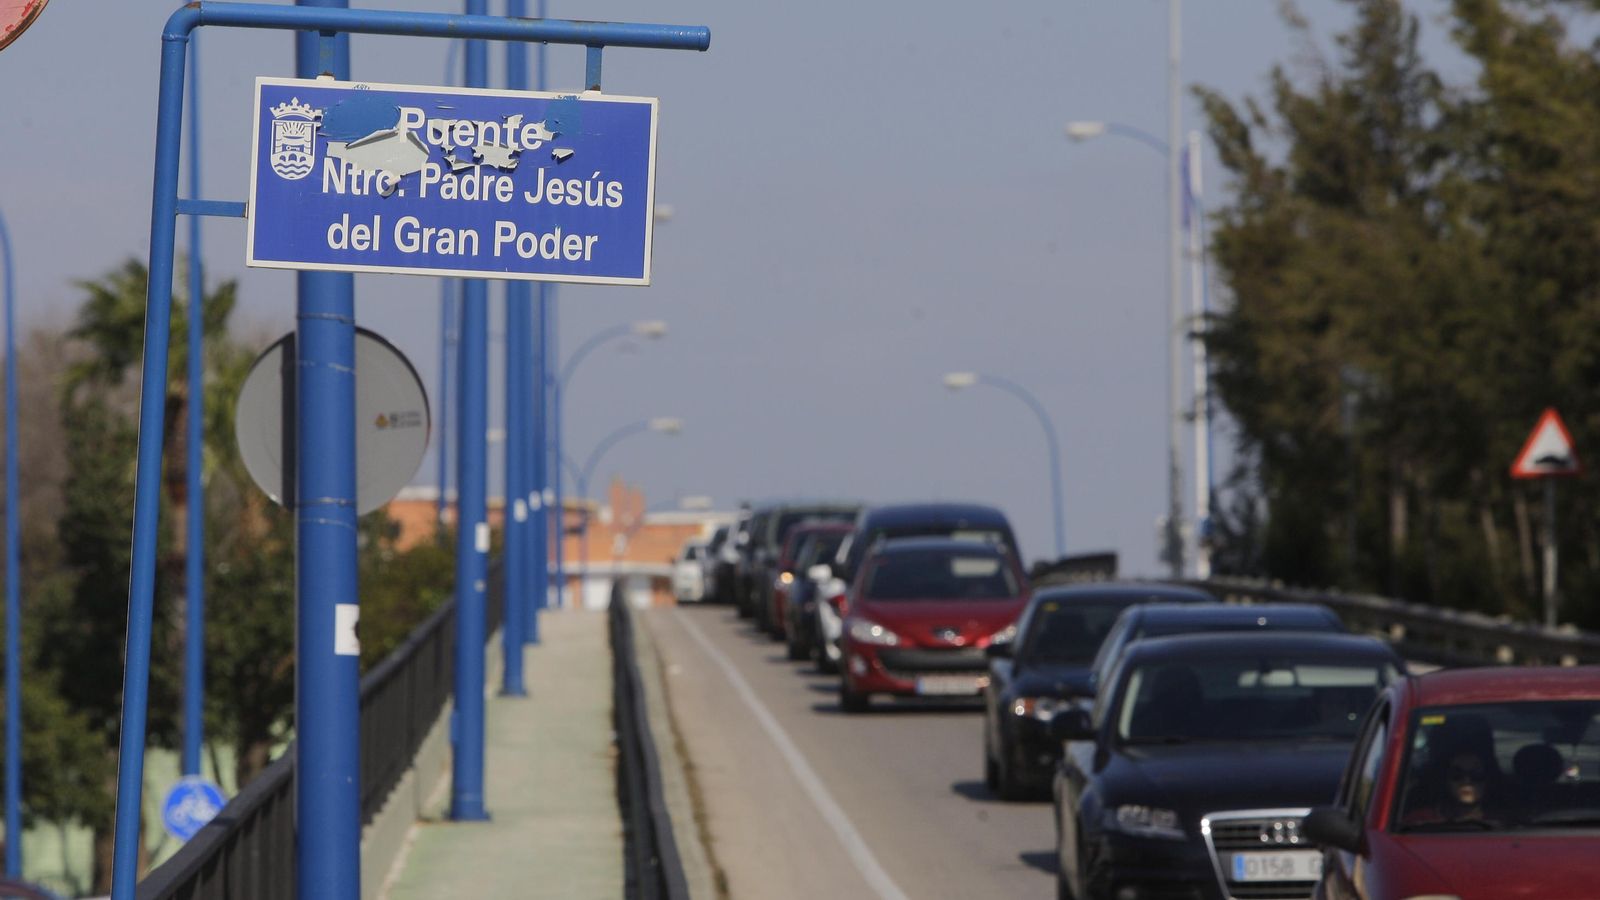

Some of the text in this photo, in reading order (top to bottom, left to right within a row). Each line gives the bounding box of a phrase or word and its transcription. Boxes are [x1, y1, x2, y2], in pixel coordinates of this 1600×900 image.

[399, 106, 543, 150] Puente
[322, 157, 623, 208] Ntro. Padre Jesús
[326, 213, 598, 261] del Gran Poder
